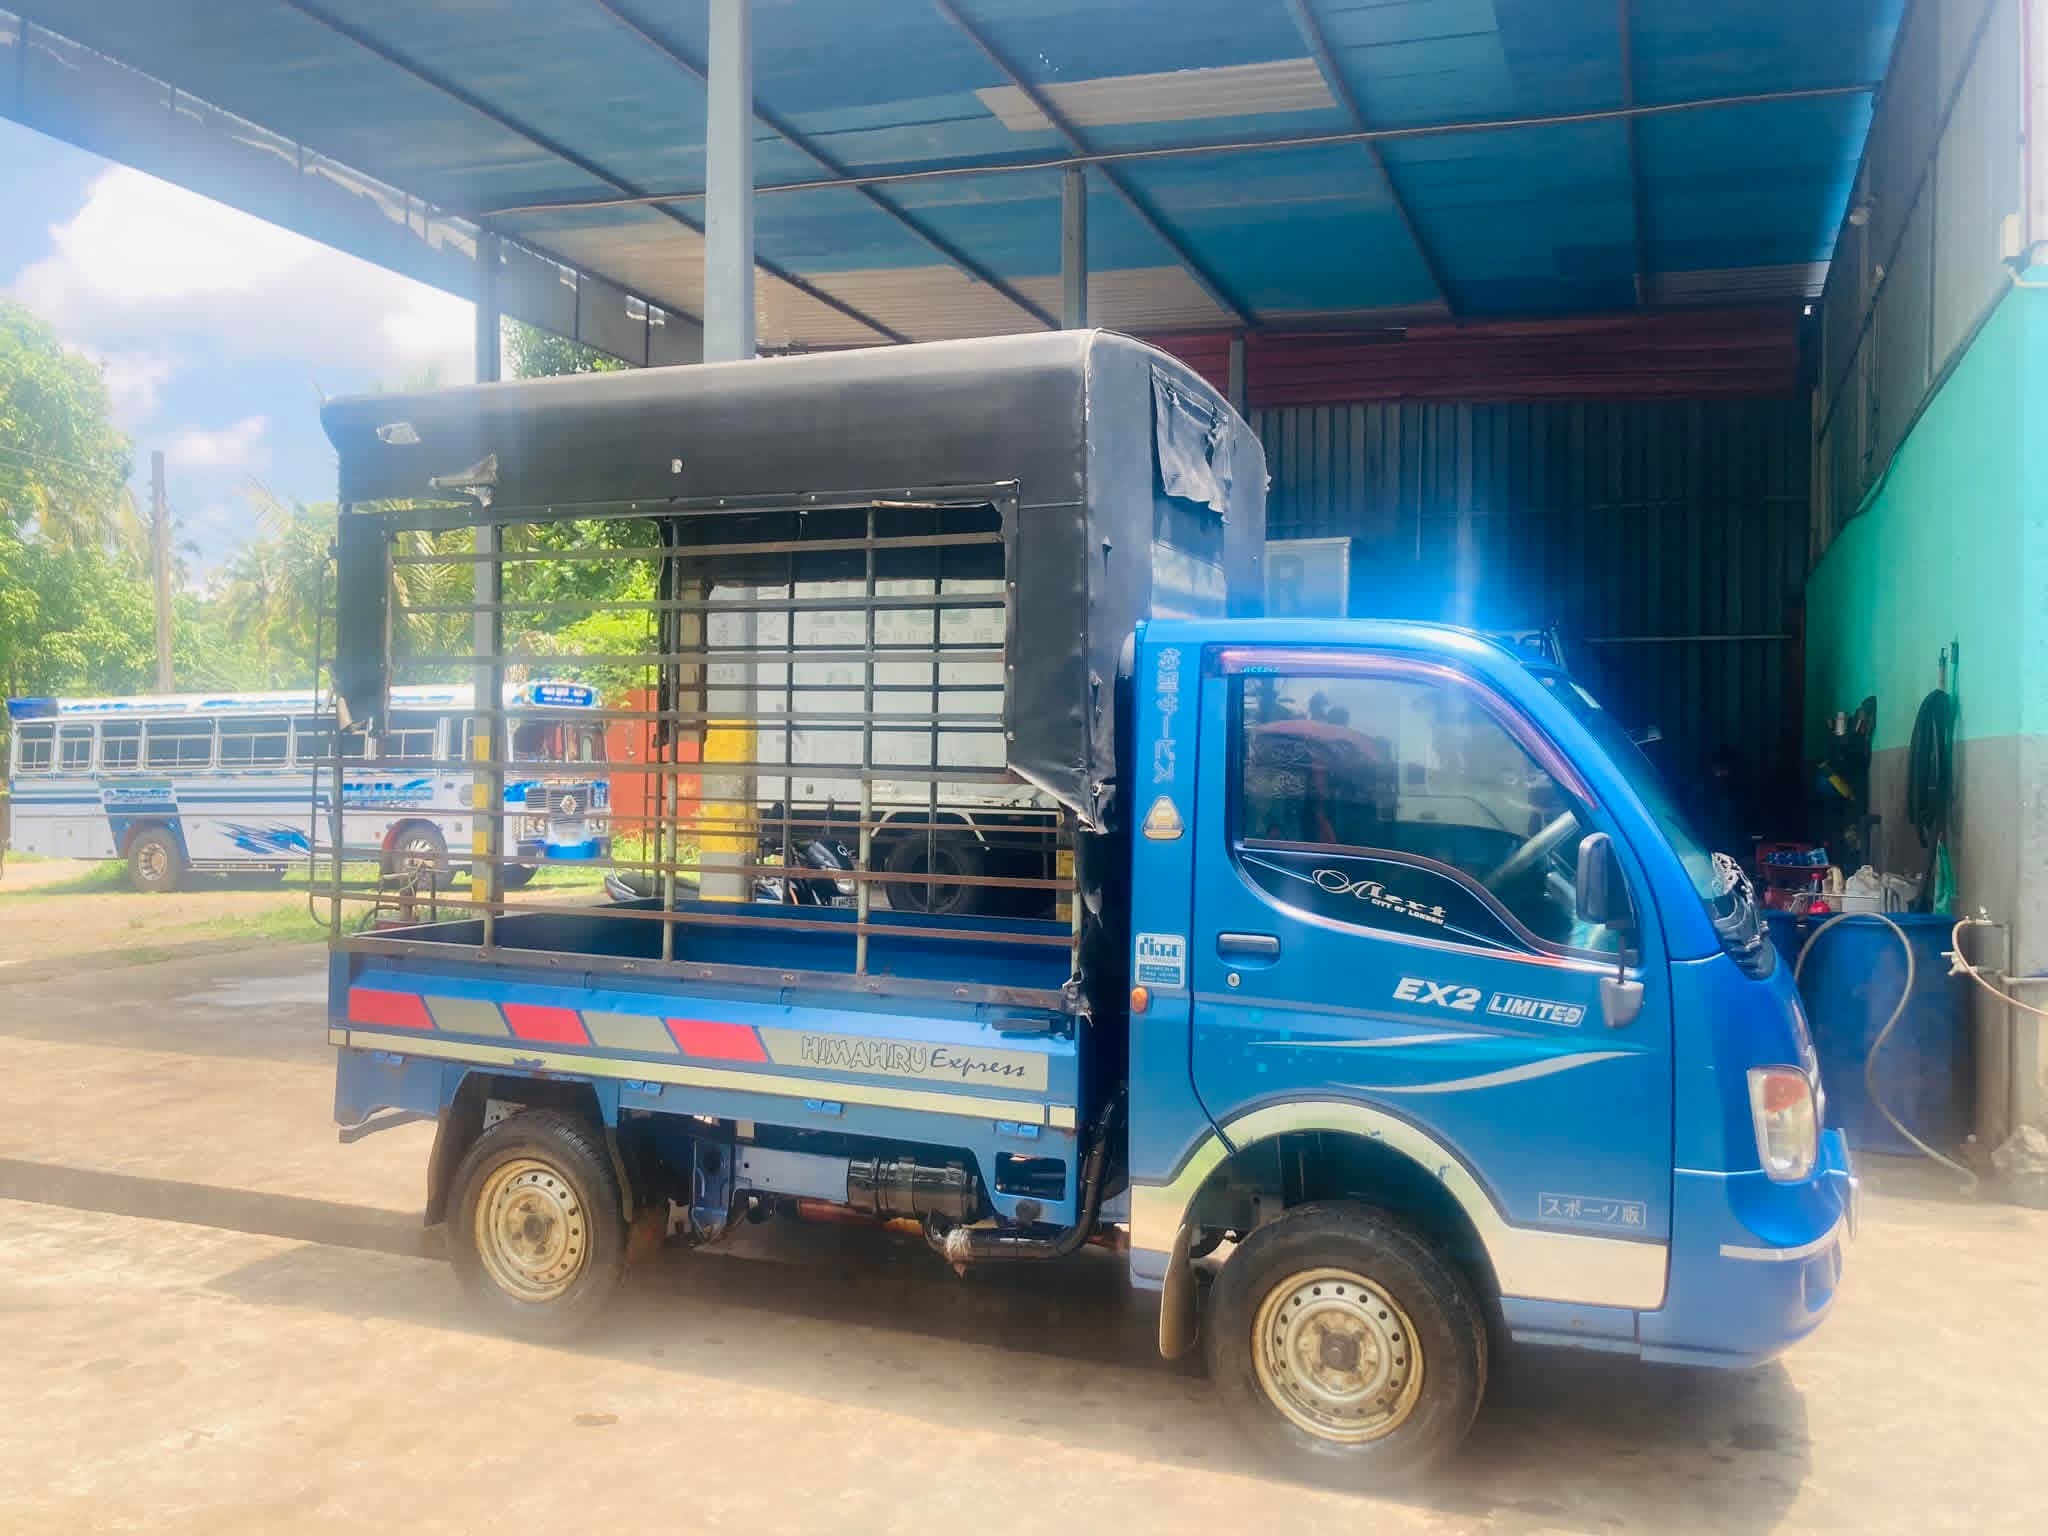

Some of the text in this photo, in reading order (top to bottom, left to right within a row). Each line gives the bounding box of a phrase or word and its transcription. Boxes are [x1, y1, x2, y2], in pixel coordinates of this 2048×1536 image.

[1392, 977, 1582, 1023] EX2 LIMITED
[930, 1048, 1025, 1077] Express
